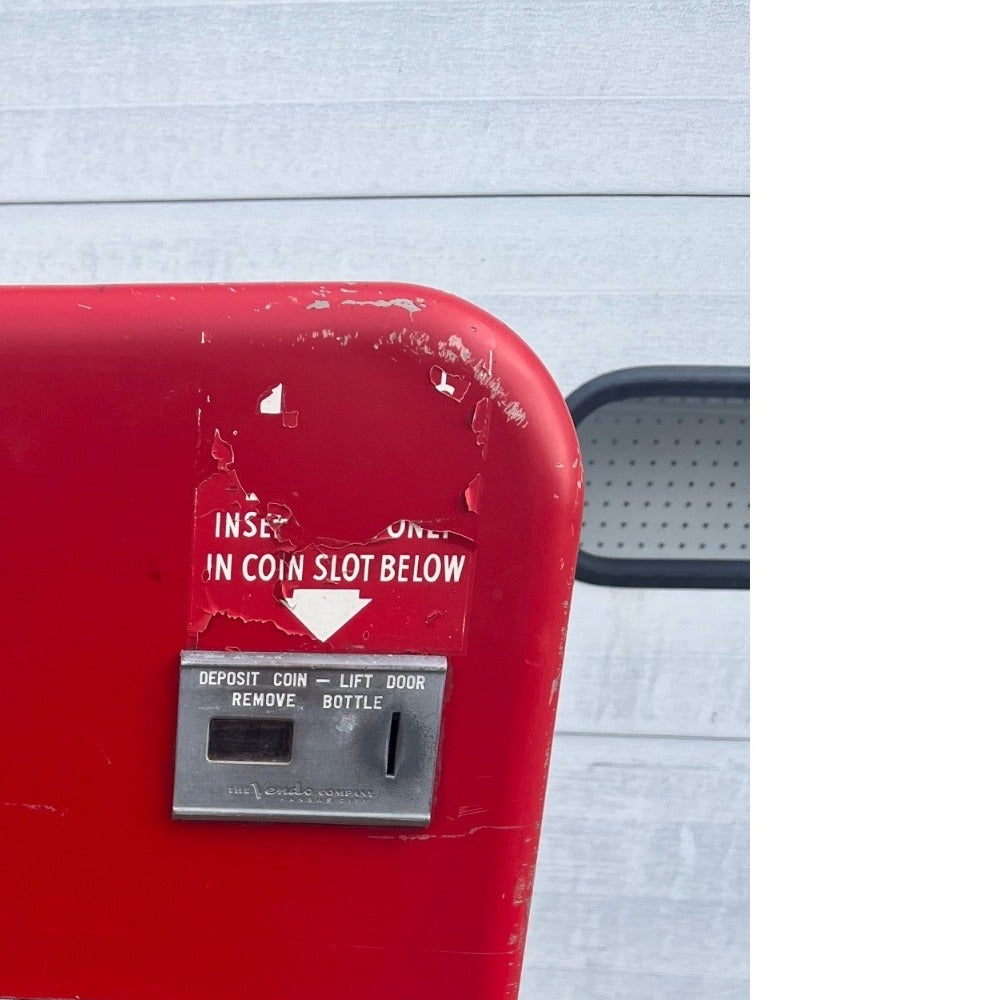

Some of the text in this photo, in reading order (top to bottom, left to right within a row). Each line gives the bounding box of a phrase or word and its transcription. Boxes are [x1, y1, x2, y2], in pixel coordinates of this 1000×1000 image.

[206, 553, 466, 583] IN COIN SLOT BELOW
[199, 670, 261, 687] DEPOSIT
[273, 672, 308, 687] COIN
[339, 673, 374, 688] LIFT
[386, 674, 426, 690] DOOR
[231, 692, 383, 710] REMOVE BOTTLE
